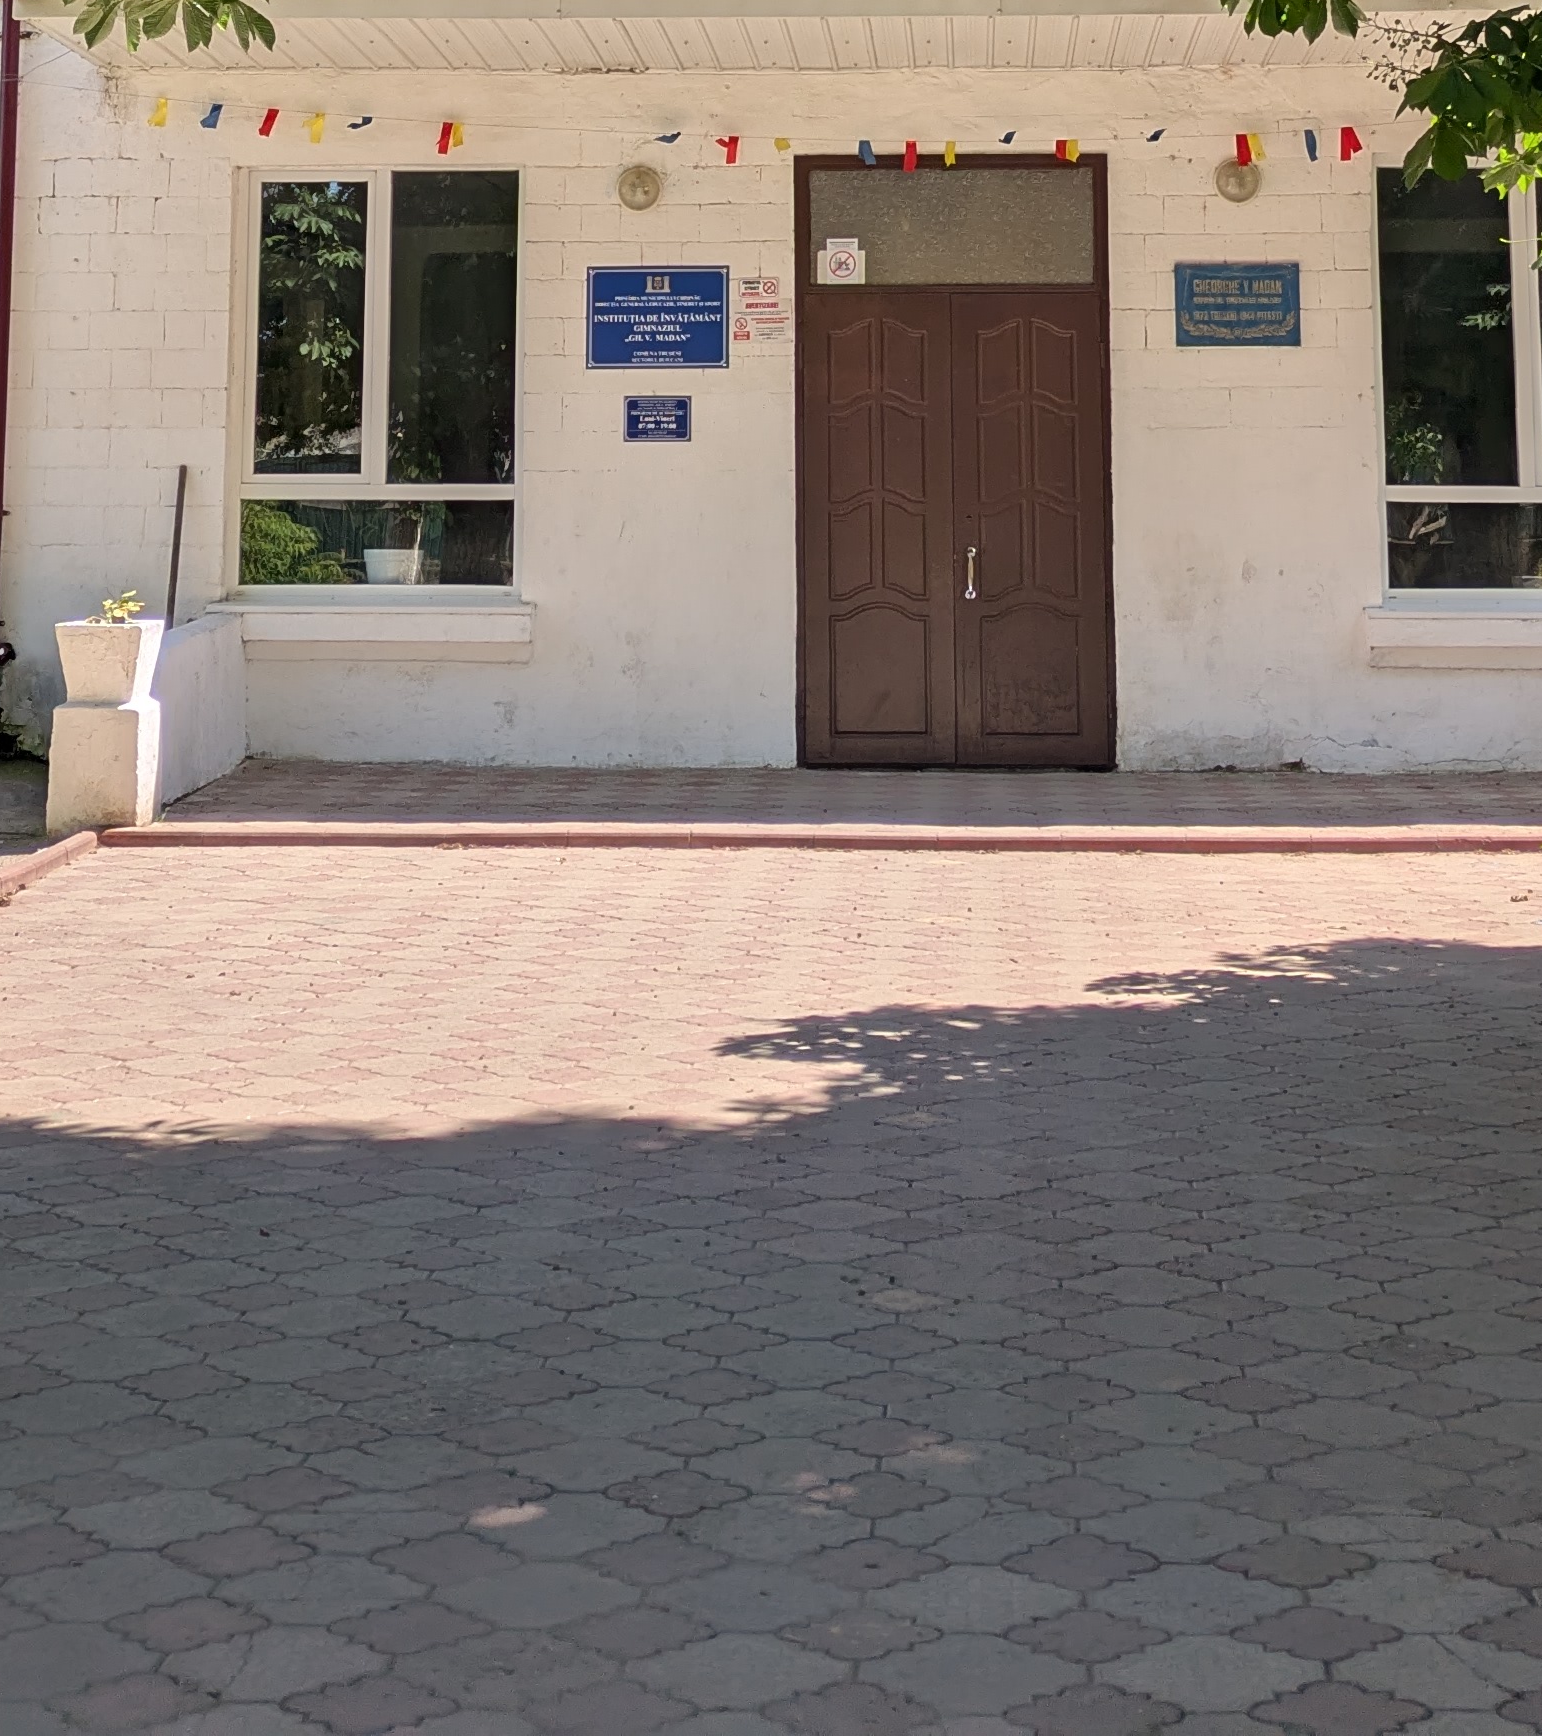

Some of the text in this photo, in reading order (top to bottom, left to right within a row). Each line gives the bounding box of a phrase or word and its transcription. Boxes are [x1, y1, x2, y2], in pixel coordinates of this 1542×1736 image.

[1193, 279, 1240, 294] GHEORGHE
[1252, 279, 1282, 294] MADAN
[594, 312, 722, 323] INSTITUȚIA DE ÎNVĂȚĂMÂNT
